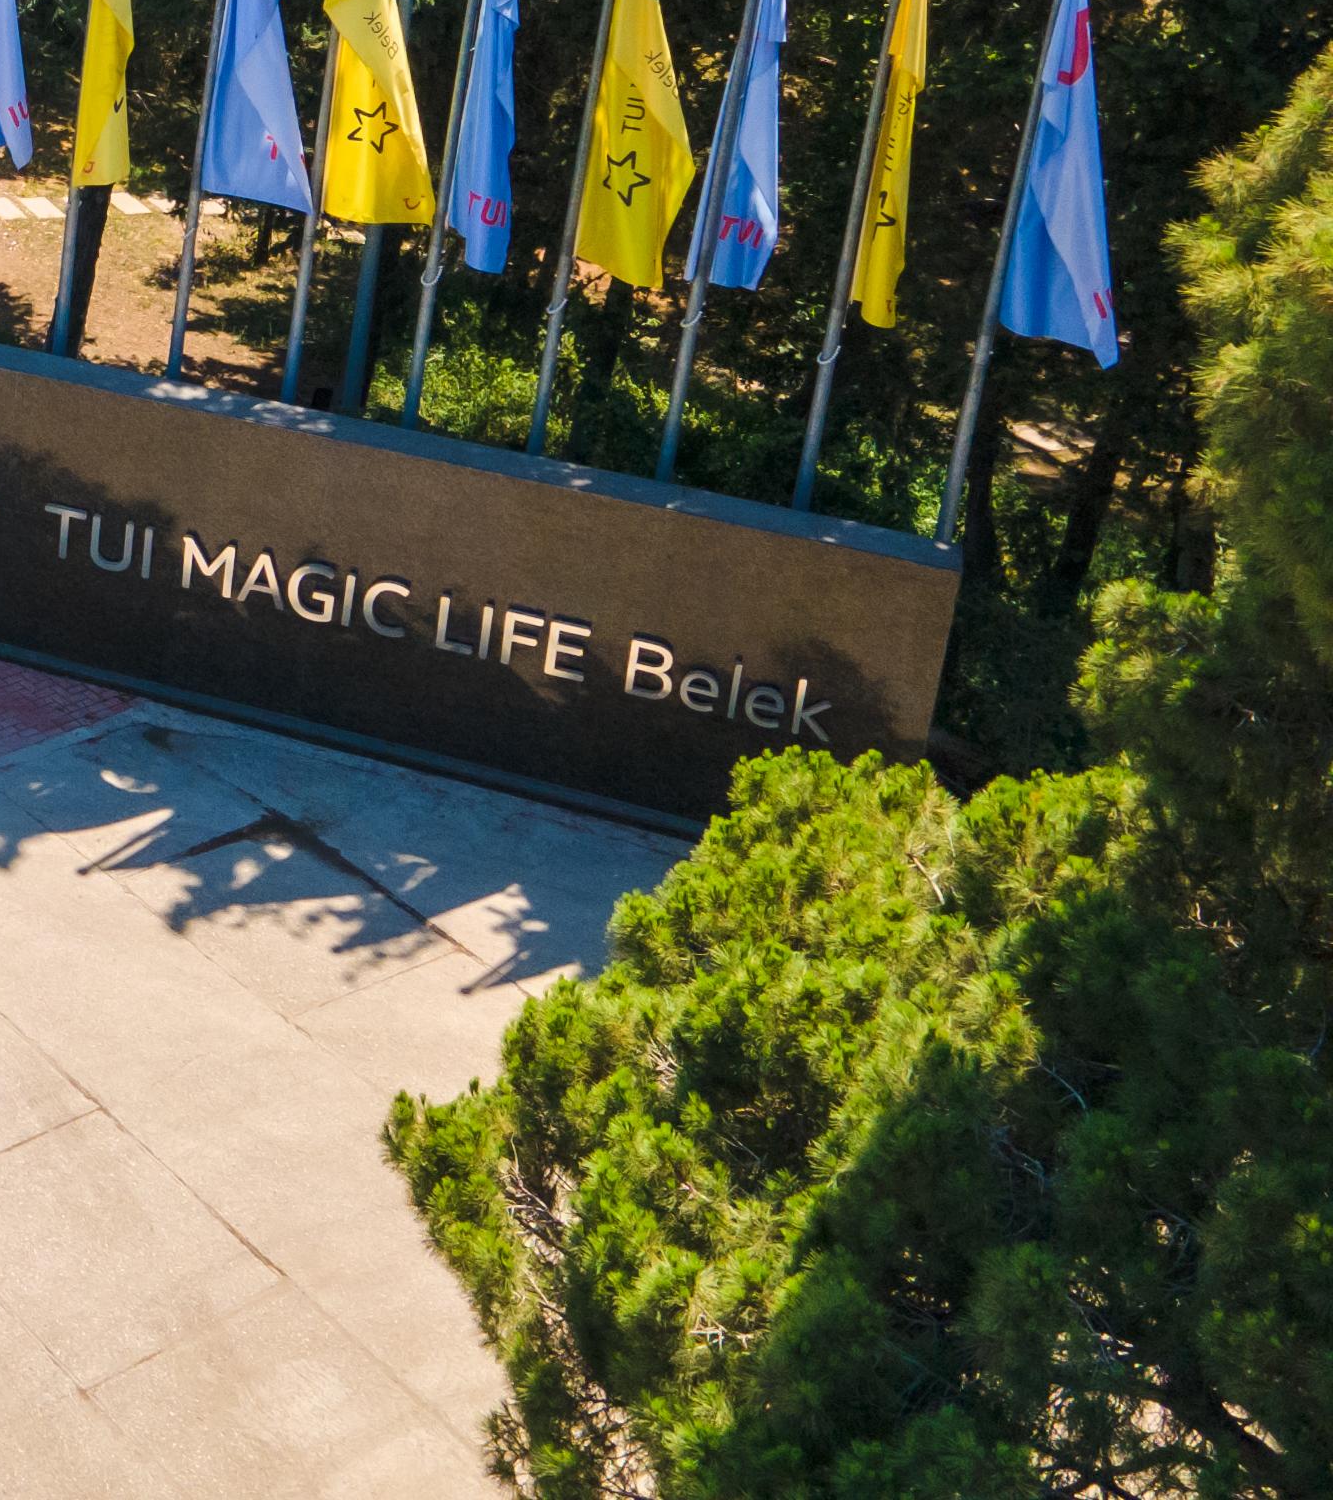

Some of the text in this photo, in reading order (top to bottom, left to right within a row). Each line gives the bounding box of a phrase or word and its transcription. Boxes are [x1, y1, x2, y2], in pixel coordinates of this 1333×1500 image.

[621, 97, 646, 135] TUI
[468, 190, 507, 228] TUI
[718, 214, 764, 249] TUI
[44, 503, 832, 742] TUI MAGIC LIFE Belek
